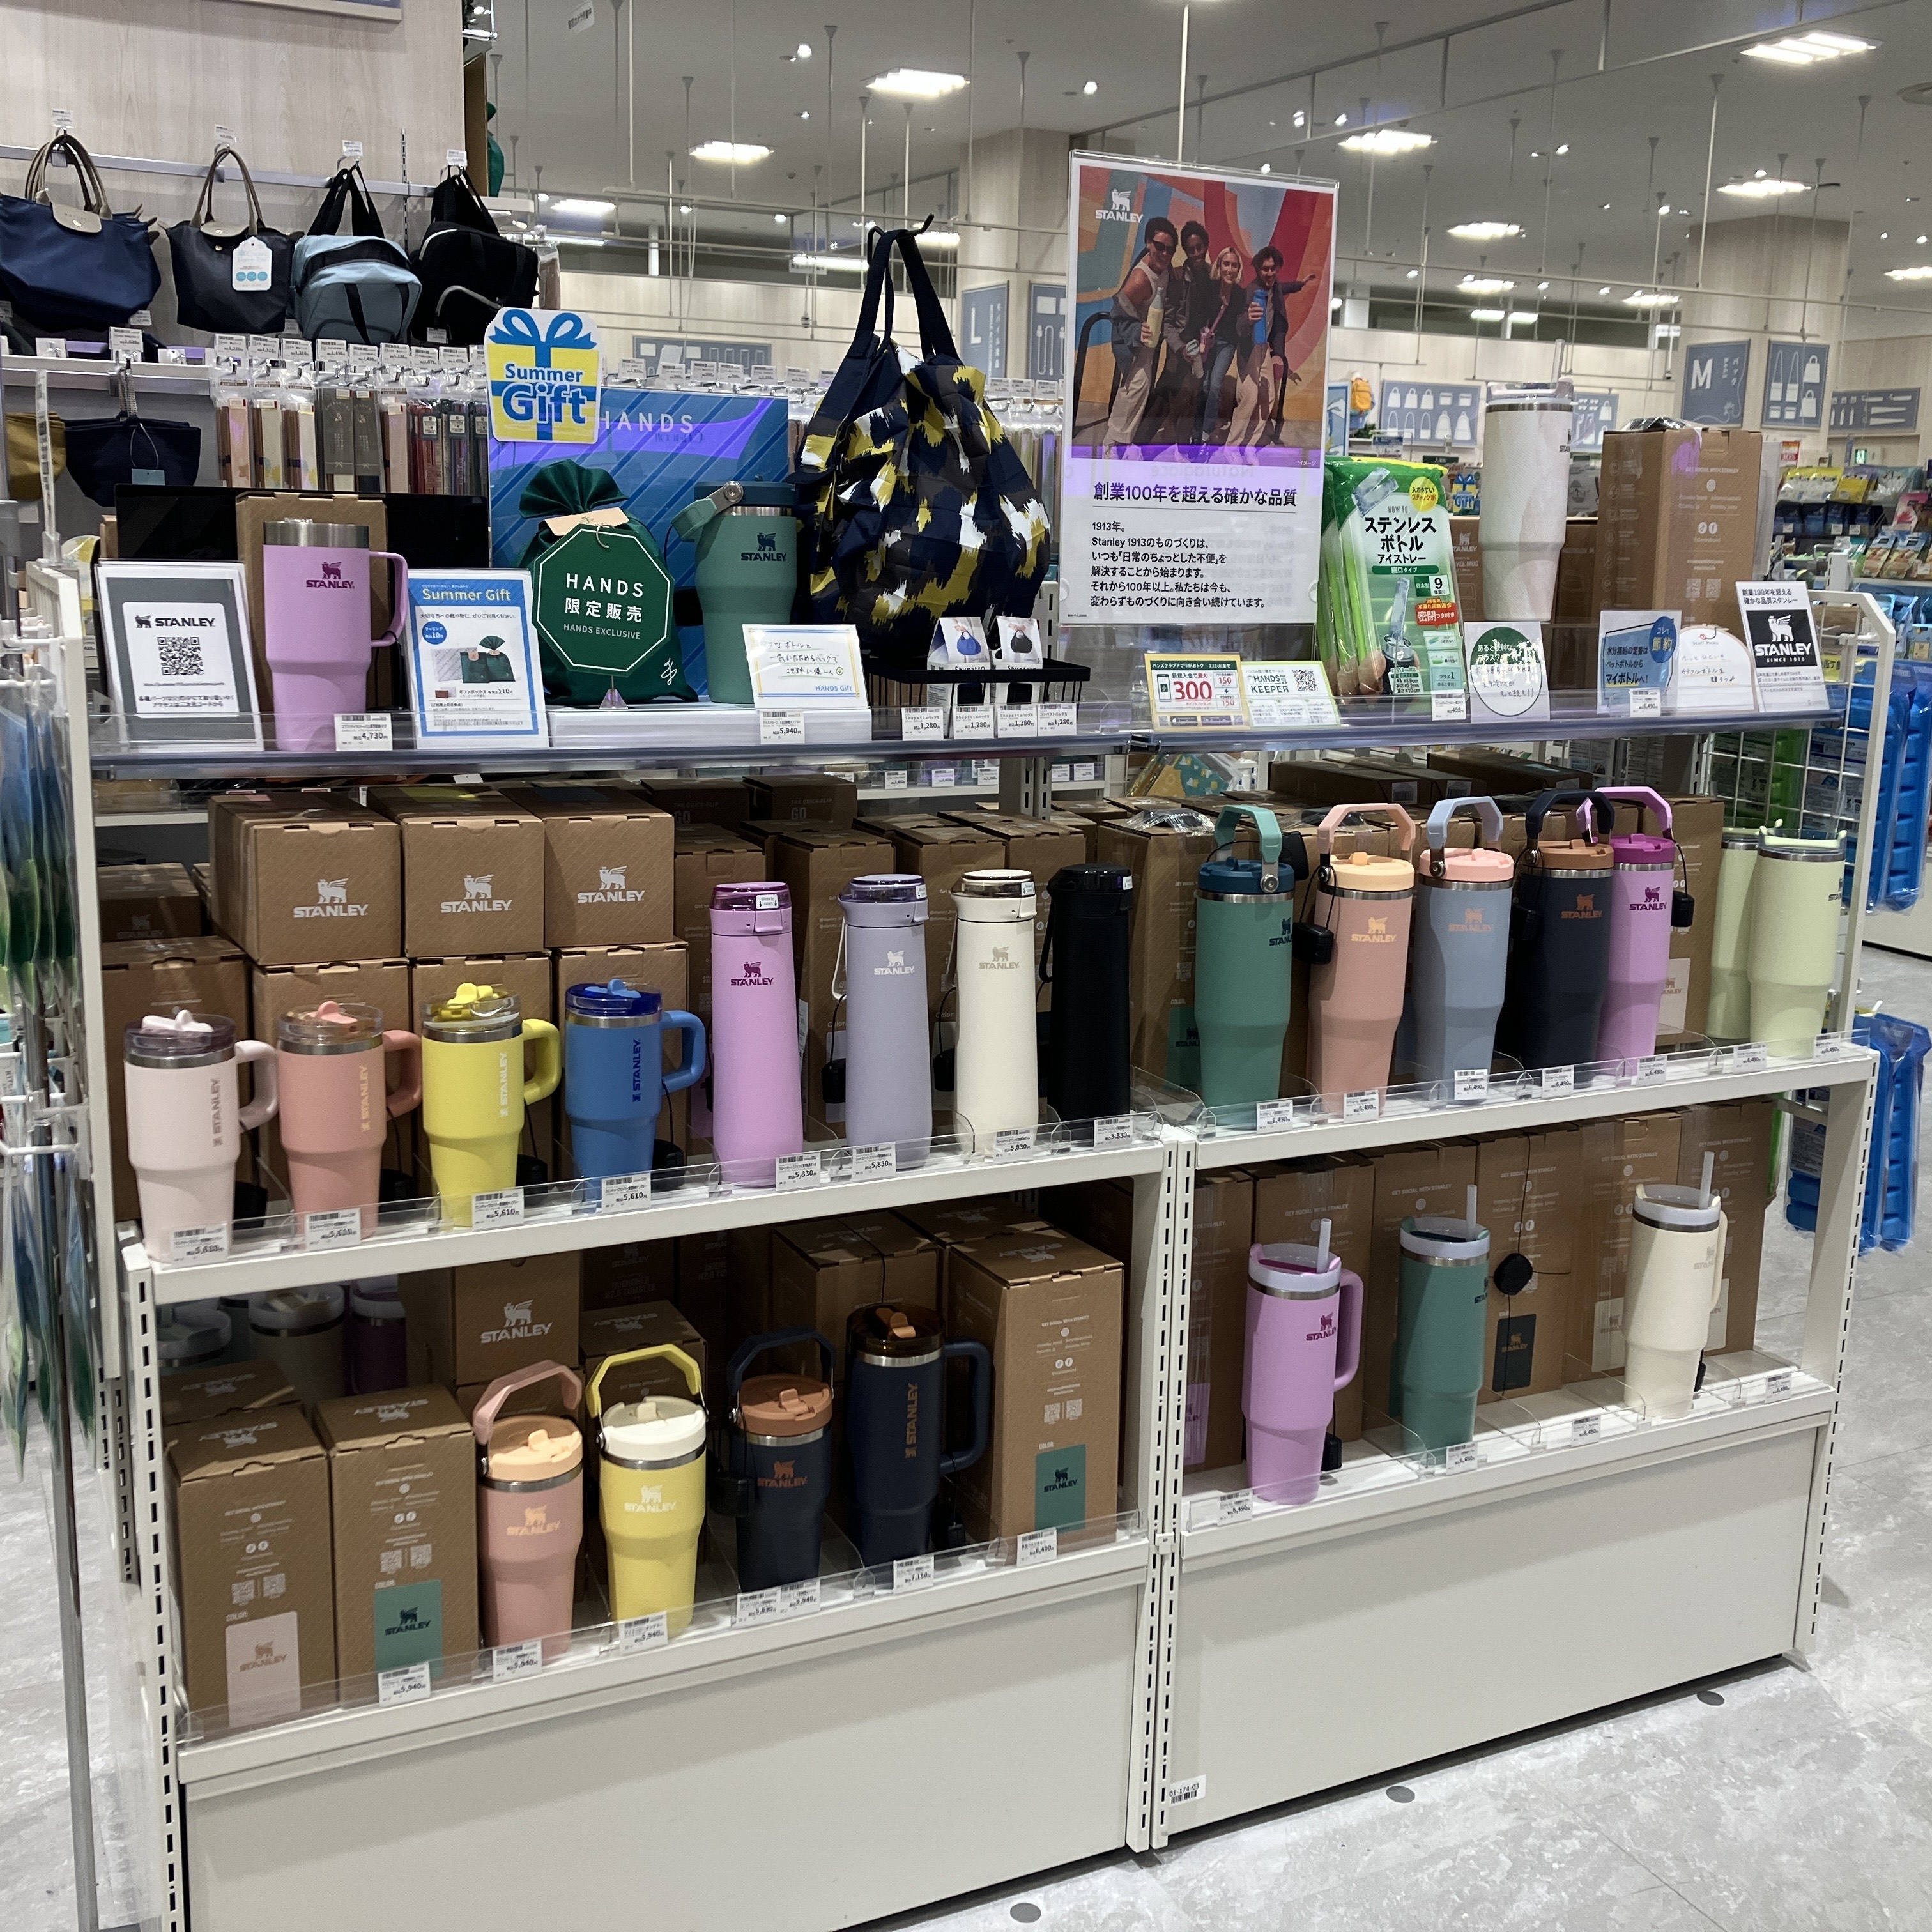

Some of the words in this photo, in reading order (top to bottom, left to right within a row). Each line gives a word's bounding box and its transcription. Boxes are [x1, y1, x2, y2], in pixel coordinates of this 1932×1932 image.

[1094, 209, 1144, 223] STANLEY
[505, 363, 583, 383] Summer
[1690, 358, 1713, 390] M
[502, 383, 587, 425] Gift
[1093, 481, 1298, 507] 創業100年を超える確かな品質
[1092, 521, 1126, 532] 1913年。
[1365, 517, 1438, 533] ステンレス
[1091, 537, 1126, 548] Stanley
[1126, 537, 1209, 549] 1913のものづくりは、
[1380, 534, 1424, 553] ボトル
[740, 552, 787, 562] STANLEY
[1092, 551, 1227, 564] いつも「日常のちょっとした不便」を
[1377, 554, 1426, 564] アイストレー
[1091, 566, 1204, 578] 解決することから始まります。
[305, 579, 355, 589] STANLEY
[565, 572, 644, 597] HANDS
[1091, 581, 1231, 593] それから100年以上。私たちは今も、
[1434, 577, 1443, 589] 9
[422, 588, 482, 601] Summer
[486, 588, 511, 601] Gift
[1090, 595, 1265, 608] 変わらずものづくりに向き合い続けています。
[564, 597, 643, 623] 限定販売
[155, 618, 215, 627] STANLEY
[564, 623, 594, 634] HANDS
[595, 627, 641, 640] EXCLUSIVE
[1754, 643, 1812, 657] STANLEY
[1173, 680, 1213, 702] 300
[1251, 685, 1289, 693] KEEPER
[791, 807, 807, 820] GO
[577, 889, 645, 904] STANLEY
[293, 904, 369, 918] STANLEY
[440, 899, 512, 913] STANLEY
[1629, 901, 1667, 911] STANLEY
[1561, 910, 1604, 919] STANLEY
[1448, 923, 1494, 933] STANLEY
[1351, 934, 1397, 944] STANLEY
[873, 965, 916, 976] STANLEY
[979, 962, 1020, 970] STANLEY
[730, 976, 774, 986] STANLEY
[632, 1039, 641, 1092] STANLEY
[499, 1052, 509, 1106] STANLEY
[359, 1066, 371, 1121] STANLEY
[210, 1078, 222, 1134] STANLEY
[480, 1321, 553, 1344] STANLEY
[905, 1382, 918, 1446] STANLEY
[757, 1477, 808, 1489] STANLEY
[1043, 1479, 1078, 1493] STANLEY
[624, 1501, 677, 1512] STANLEY
[506, 1521, 561, 1537] STANLEY
[385, 1619, 431, 1636] STANLEY
[240, 1653, 288, 1672] STANLEY
